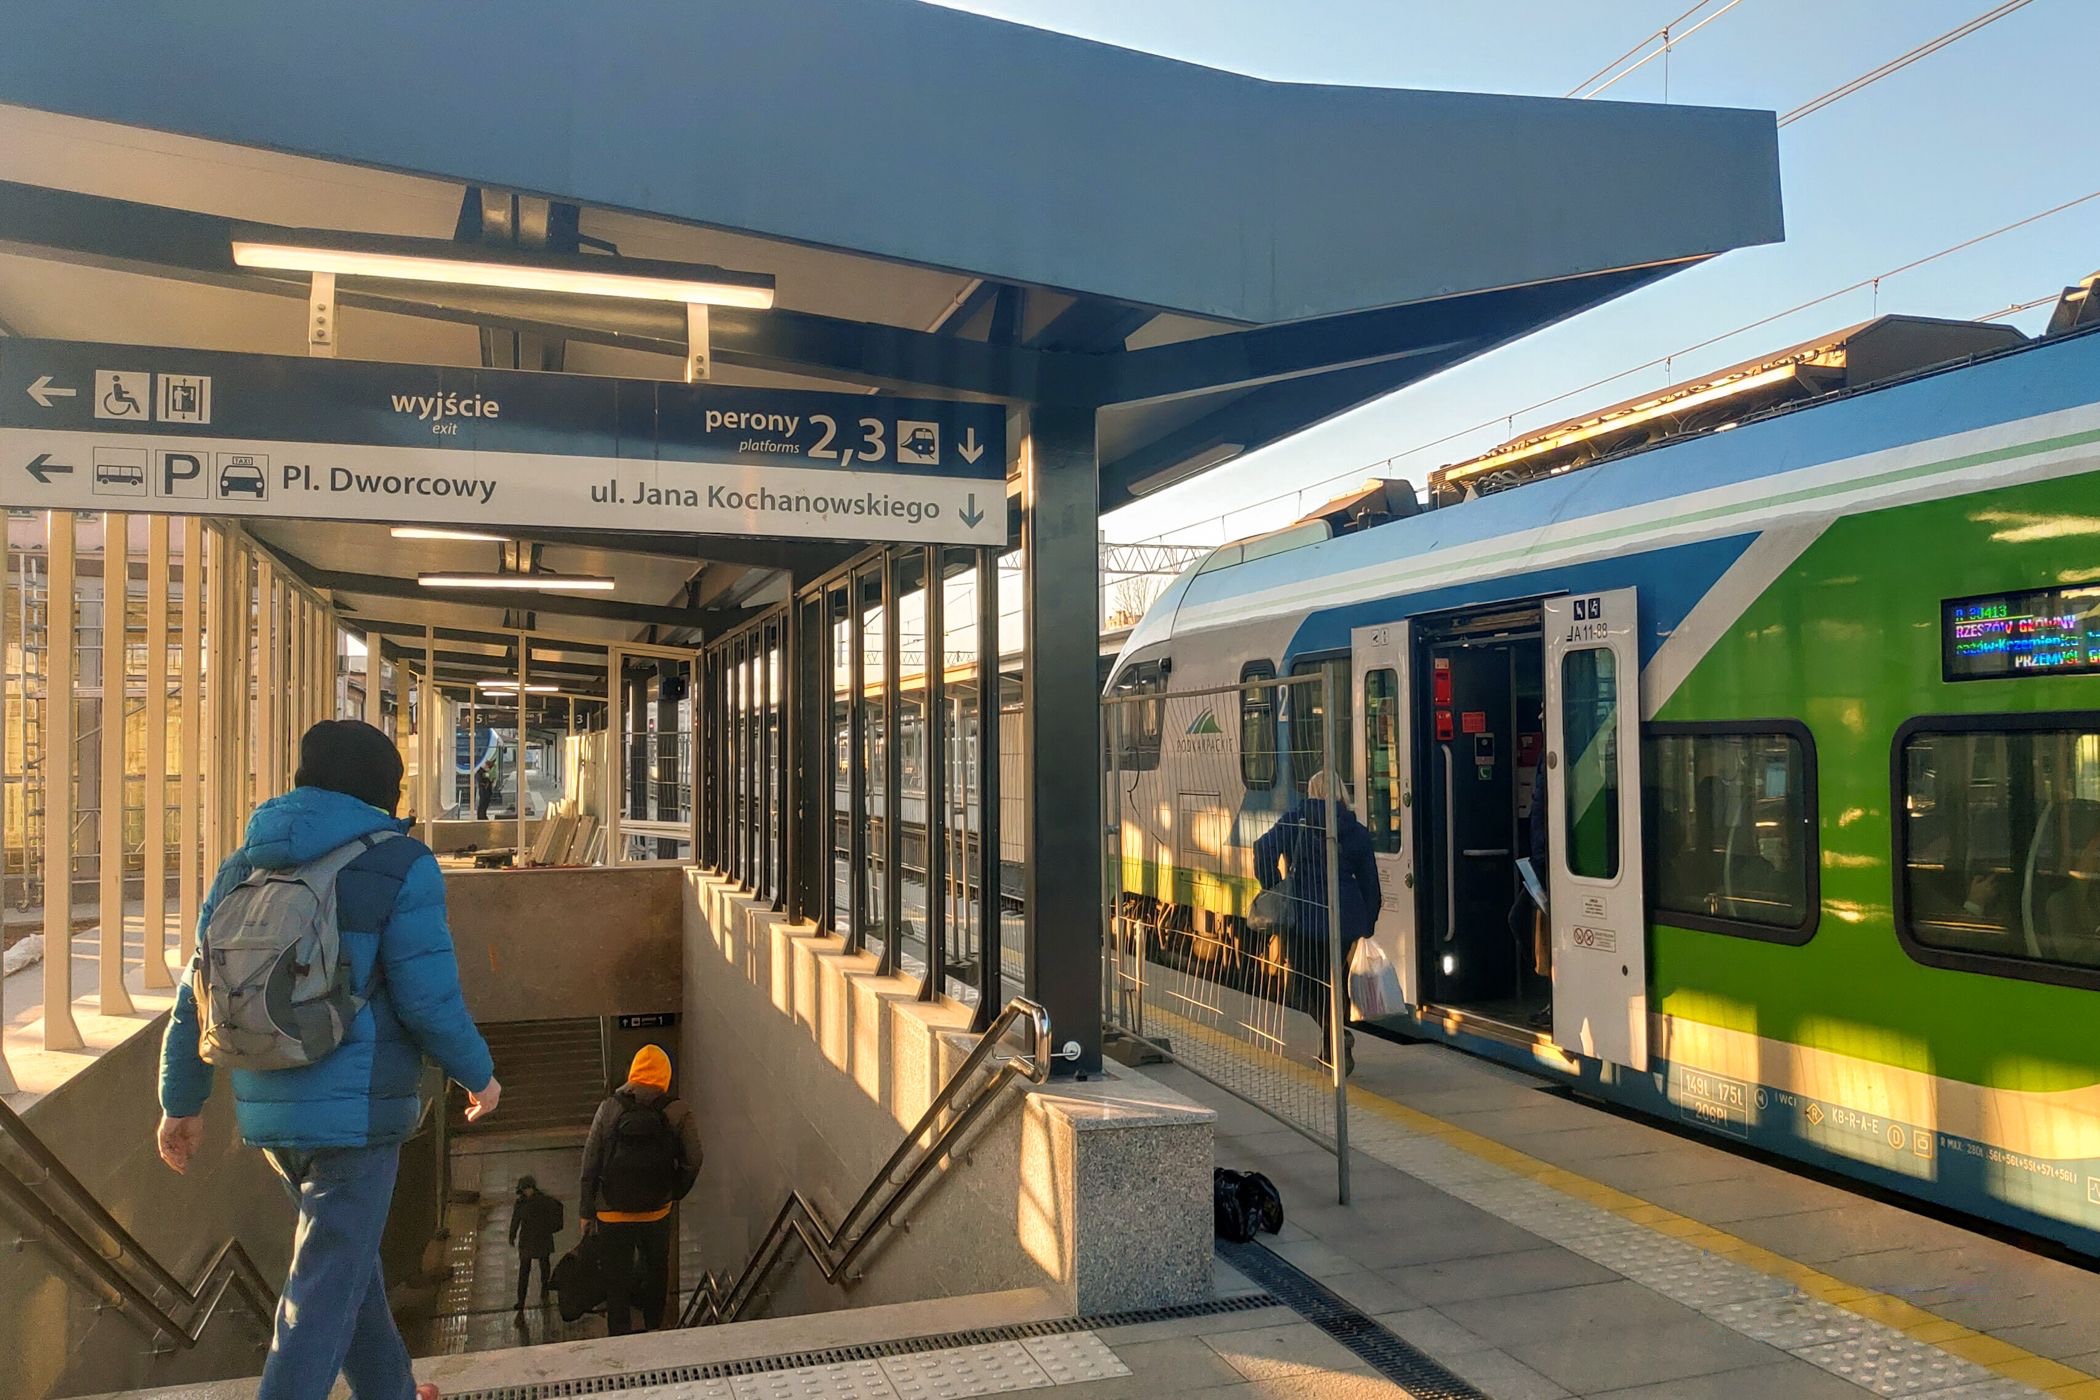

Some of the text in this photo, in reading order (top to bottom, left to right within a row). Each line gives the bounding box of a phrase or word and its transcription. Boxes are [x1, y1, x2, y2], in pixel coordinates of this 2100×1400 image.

[391, 392, 500, 421] wyjście
[432, 422, 458, 435] exit
[705, 410, 887, 467] perony 2,3
[739, 438, 800, 454] platforms
[165, 453, 201, 495] P
[233, 457, 252, 465] TAXI
[283, 464, 497, 504] Pl. Dworcowy
[591, 479, 940, 524] ul. Jana Kochanowskiego
[1278, 684, 1289, 722] 2
[1177, 737, 1234, 754] PODKARPACKIE
[1832, 1106, 1879, 1134] KB-R-A-E
